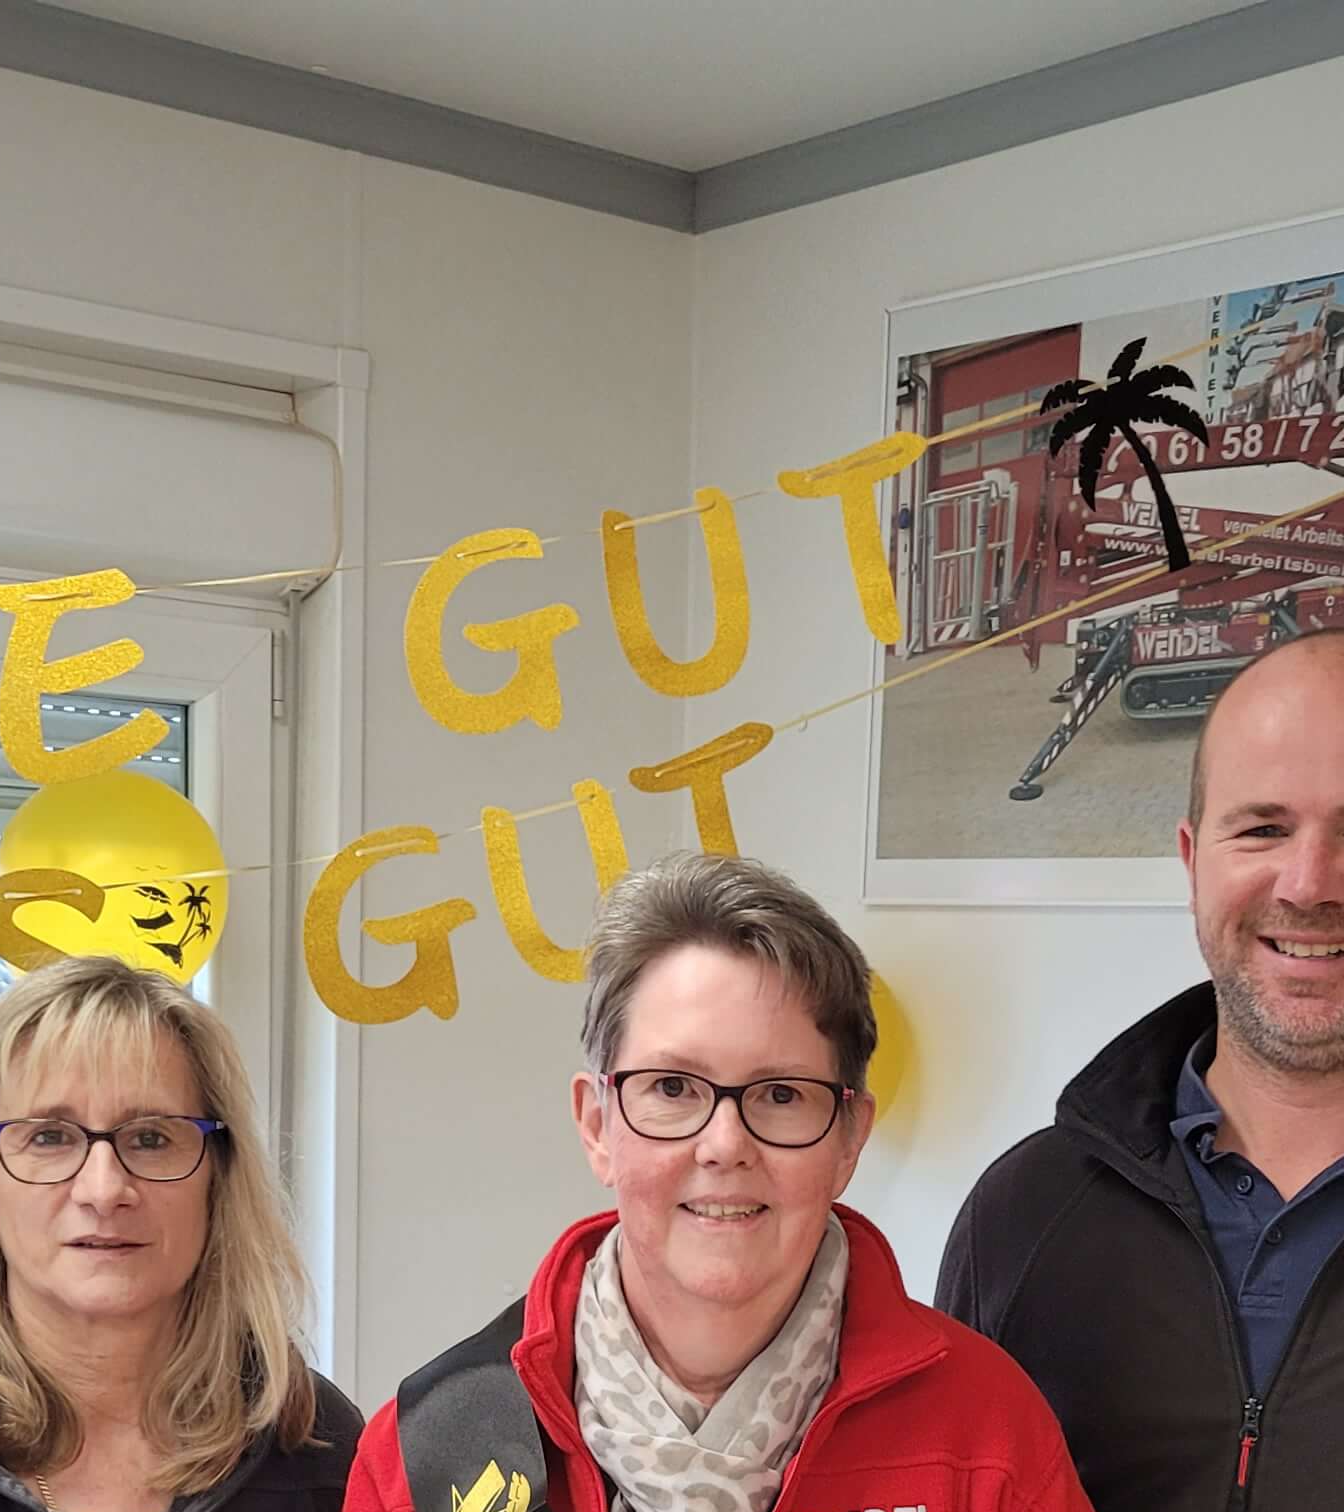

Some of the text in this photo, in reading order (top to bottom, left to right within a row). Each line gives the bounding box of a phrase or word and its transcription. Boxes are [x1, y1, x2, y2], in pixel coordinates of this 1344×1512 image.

[1168, 431, 1207, 465] 61
[1221, 424, 1264, 460] 58
[1273, 421, 1286, 456] /
[1299, 418, 1322, 451] 7
[1122, 501, 1201, 531] WEEL
[1223, 518, 1290, 541] veretet
[403, 431, 927, 735] GUT
[1135, 625, 1223, 660] WENDEL
[303, 722, 774, 1025] GUT
